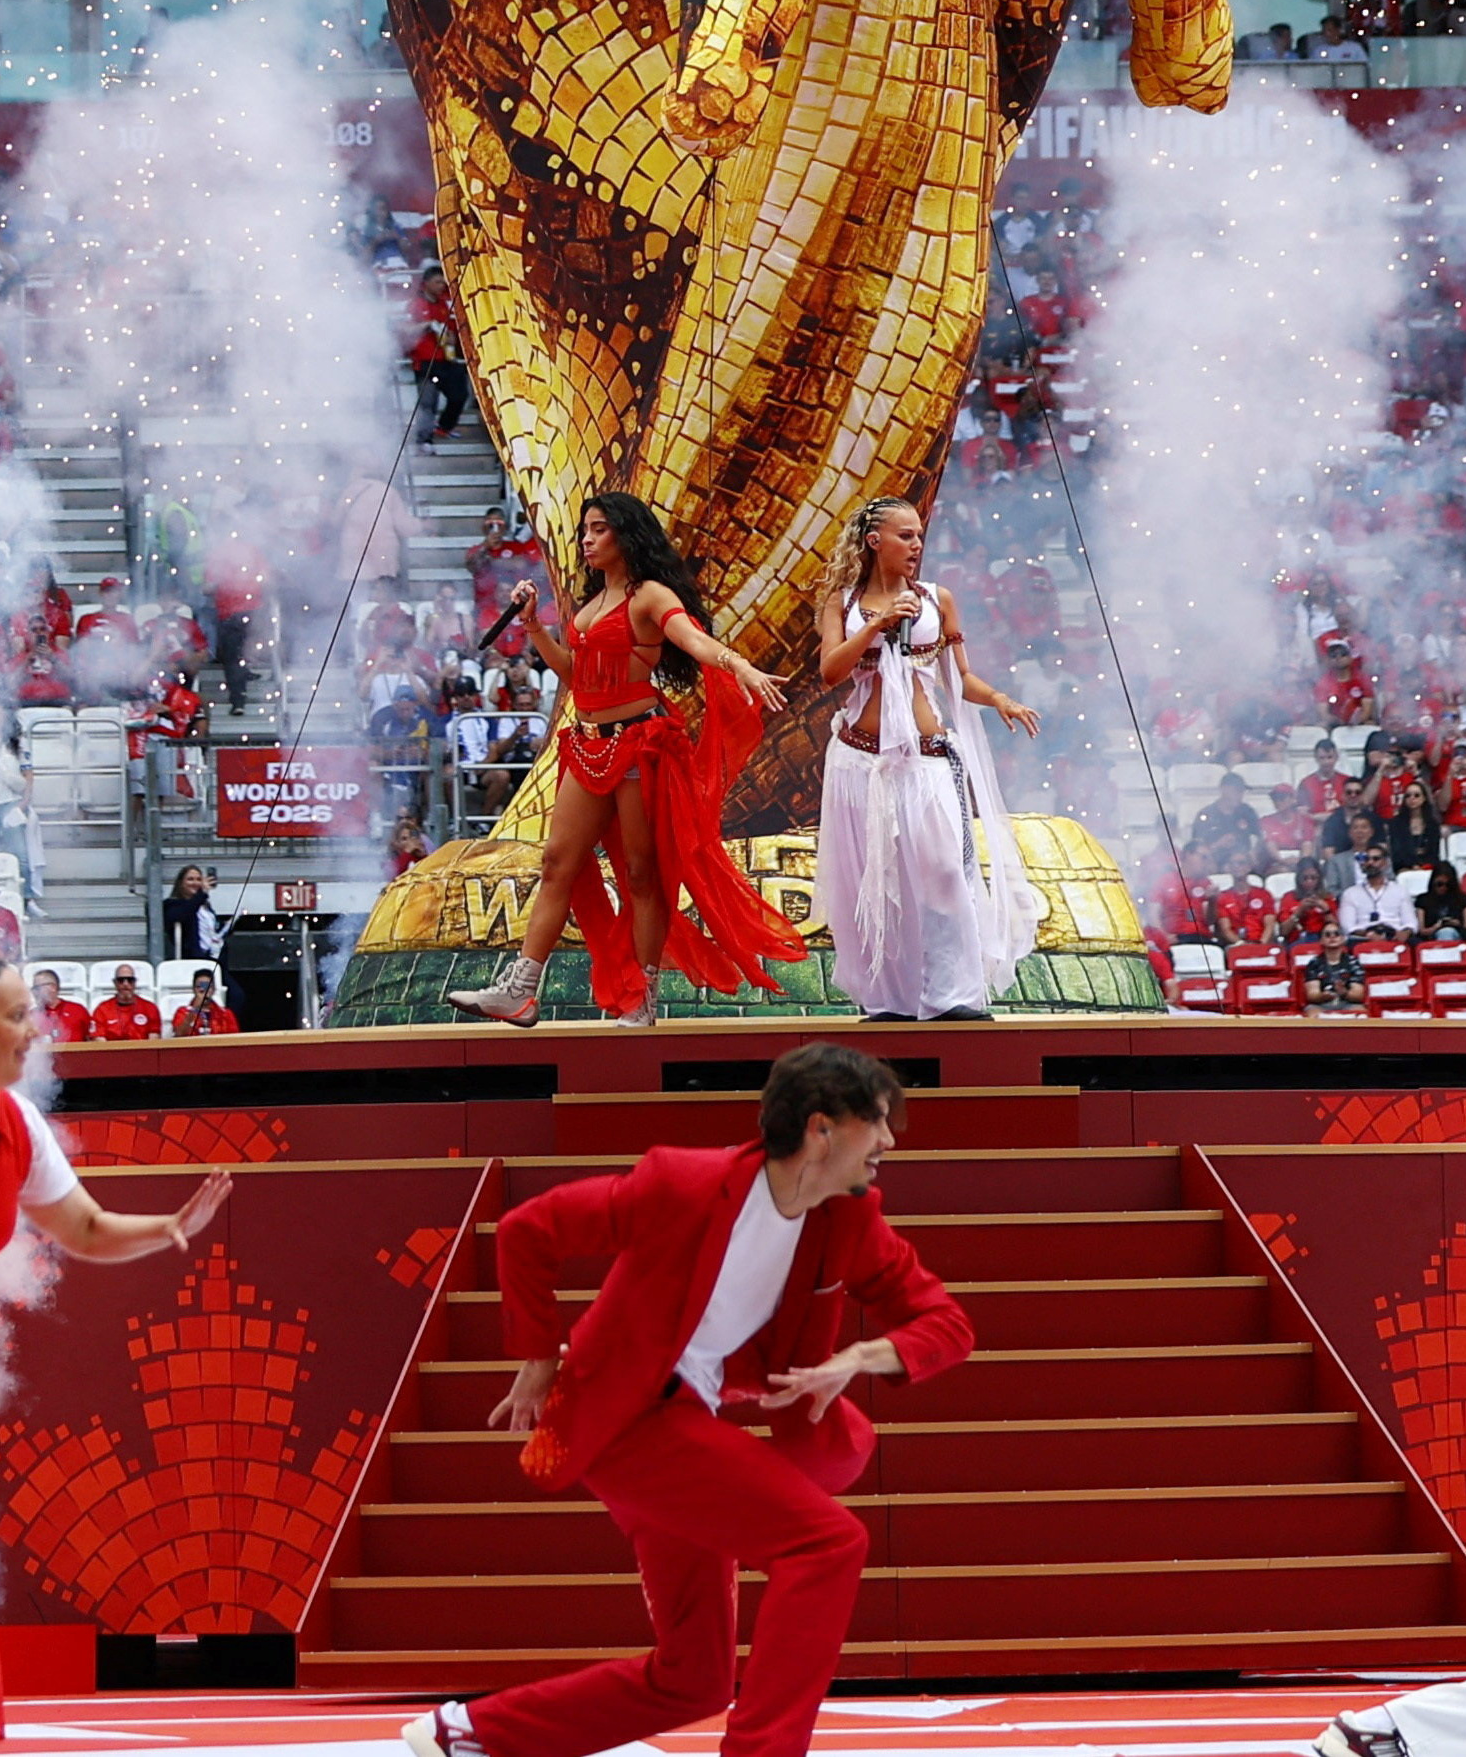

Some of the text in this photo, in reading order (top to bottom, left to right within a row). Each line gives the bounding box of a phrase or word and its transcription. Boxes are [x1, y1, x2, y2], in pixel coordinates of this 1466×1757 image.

[266, 762, 317, 780] FIFA
[225, 783, 360, 801] WORLD CUP
[250, 804, 333, 823] 2026
[281, 885, 312, 907] EXIT
